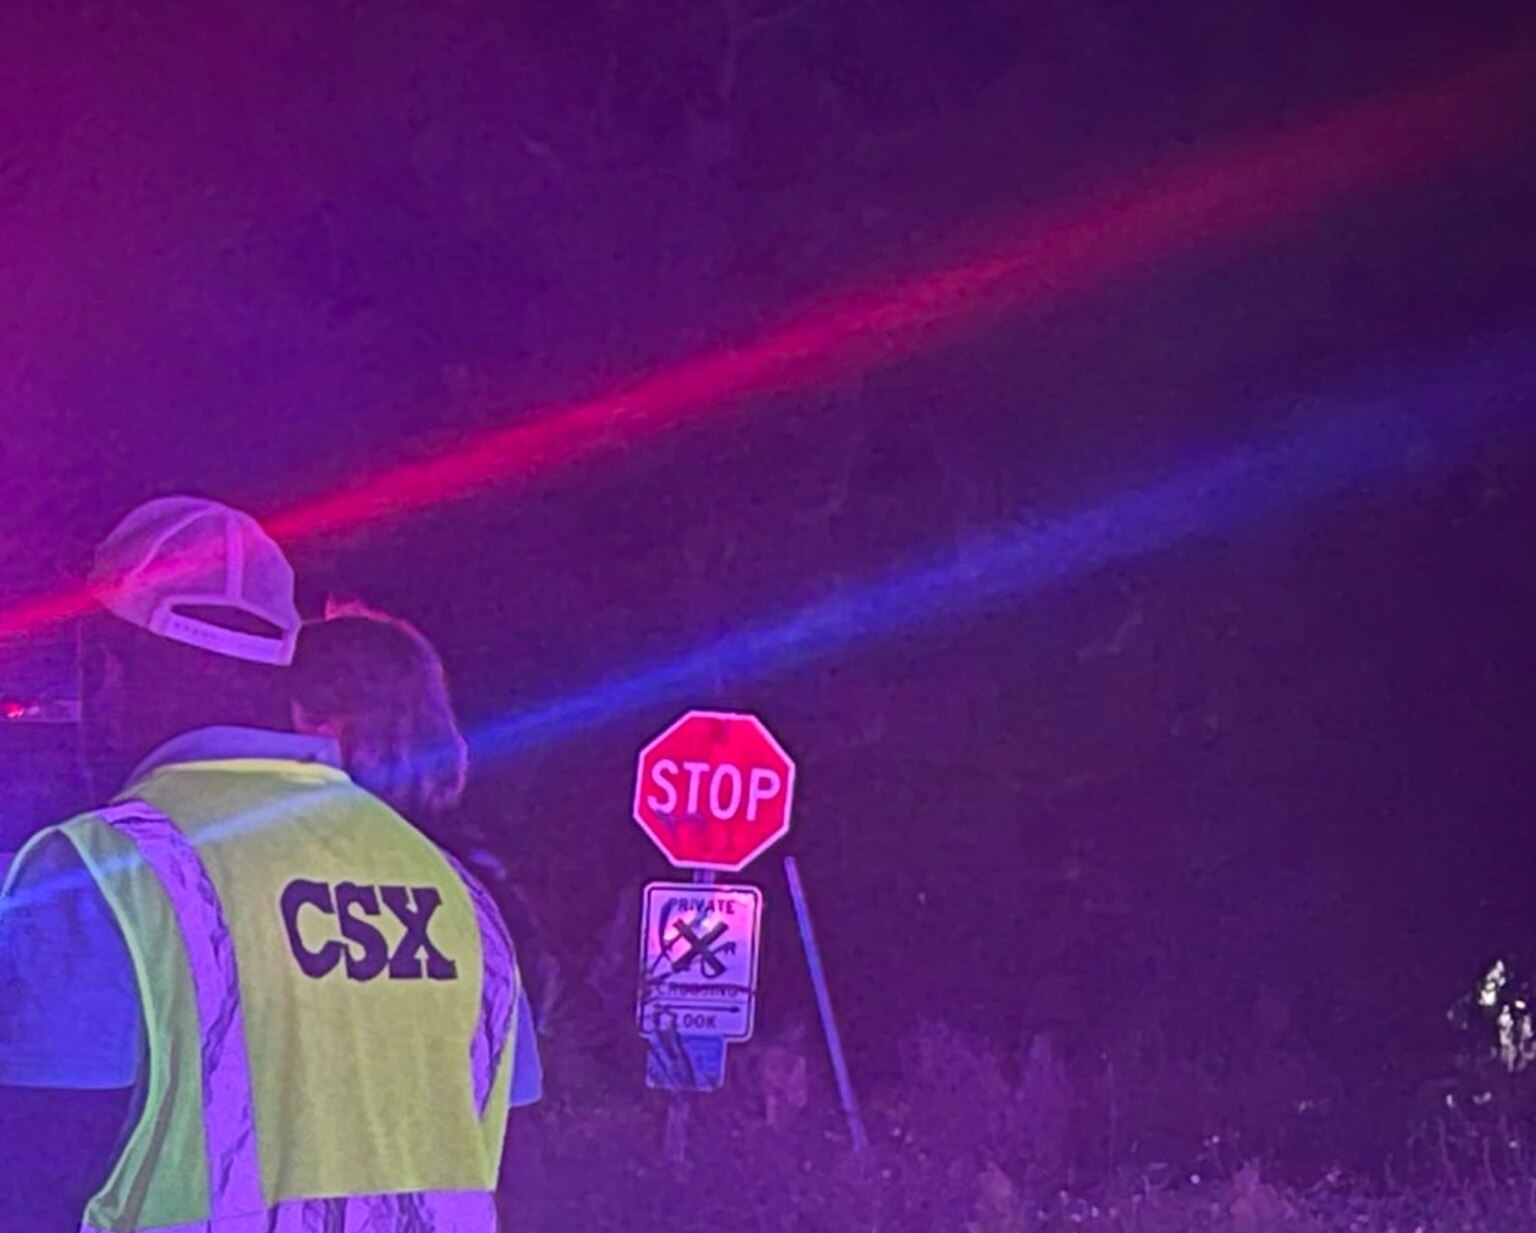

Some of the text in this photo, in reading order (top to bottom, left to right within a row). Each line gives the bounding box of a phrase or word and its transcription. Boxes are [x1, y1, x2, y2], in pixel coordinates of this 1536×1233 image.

[647, 759, 781, 821] STOP
[280, 878, 458, 982] CSX
[669, 897, 736, 915] PRIVATE
